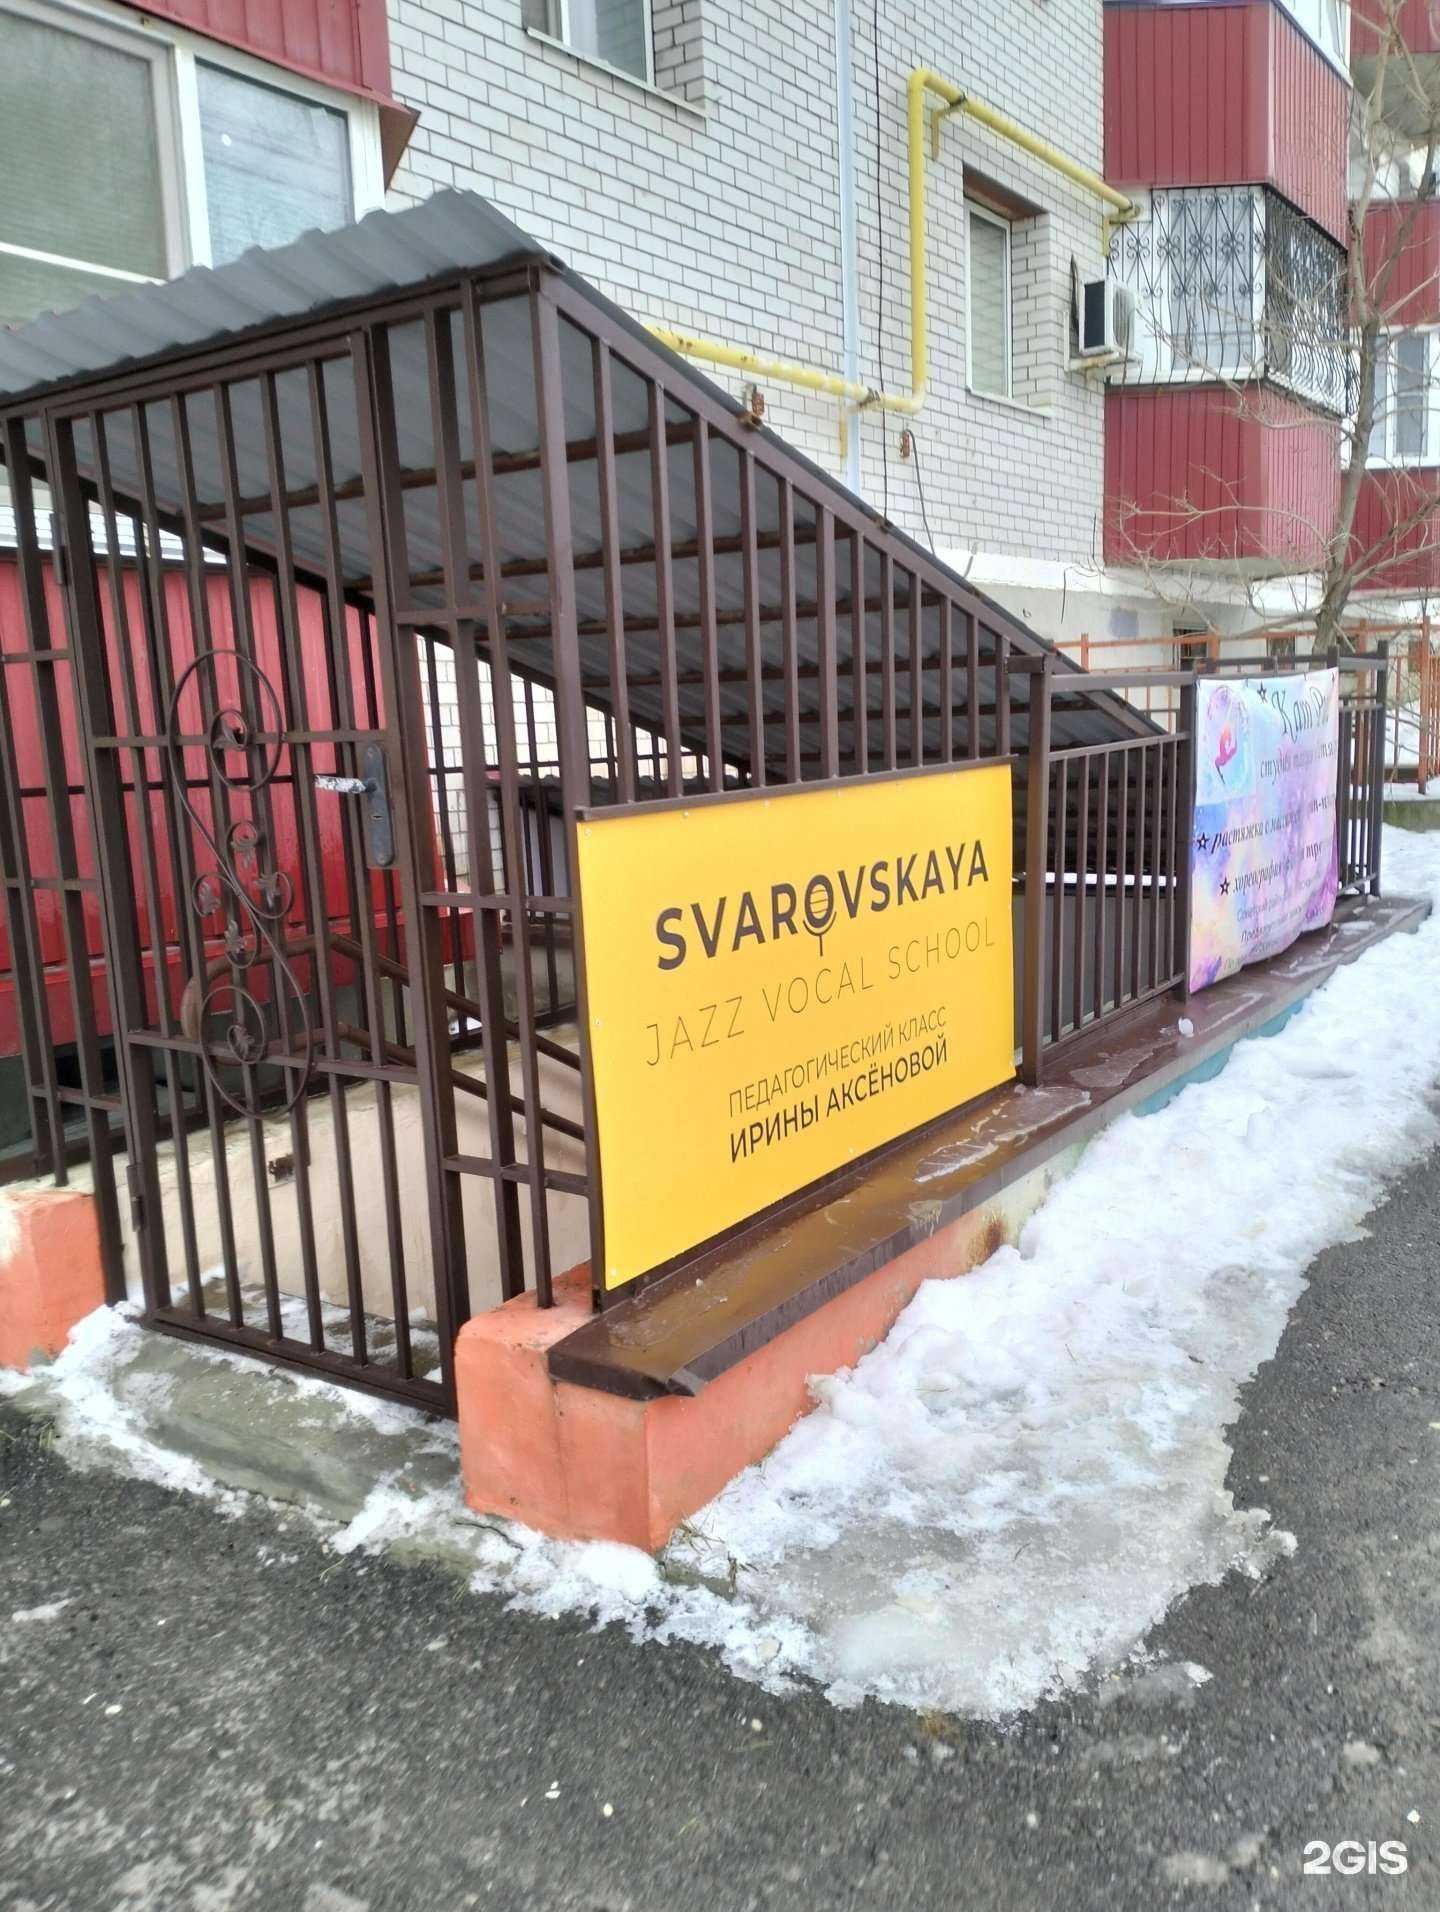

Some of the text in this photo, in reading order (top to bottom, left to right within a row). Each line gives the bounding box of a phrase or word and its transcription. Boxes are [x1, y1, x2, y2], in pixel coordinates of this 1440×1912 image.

[655, 839, 989, 971] SVAROVSKAYA
[645, 917, 996, 1067] JAZZ VOCAL SCHOOL
[728, 1006, 947, 1118] ПЕДАГОГИЧЕСКИЙ КЛАСС
[729, 1033, 949, 1164] ИРИНЫ АКСЁНОВОЙ
